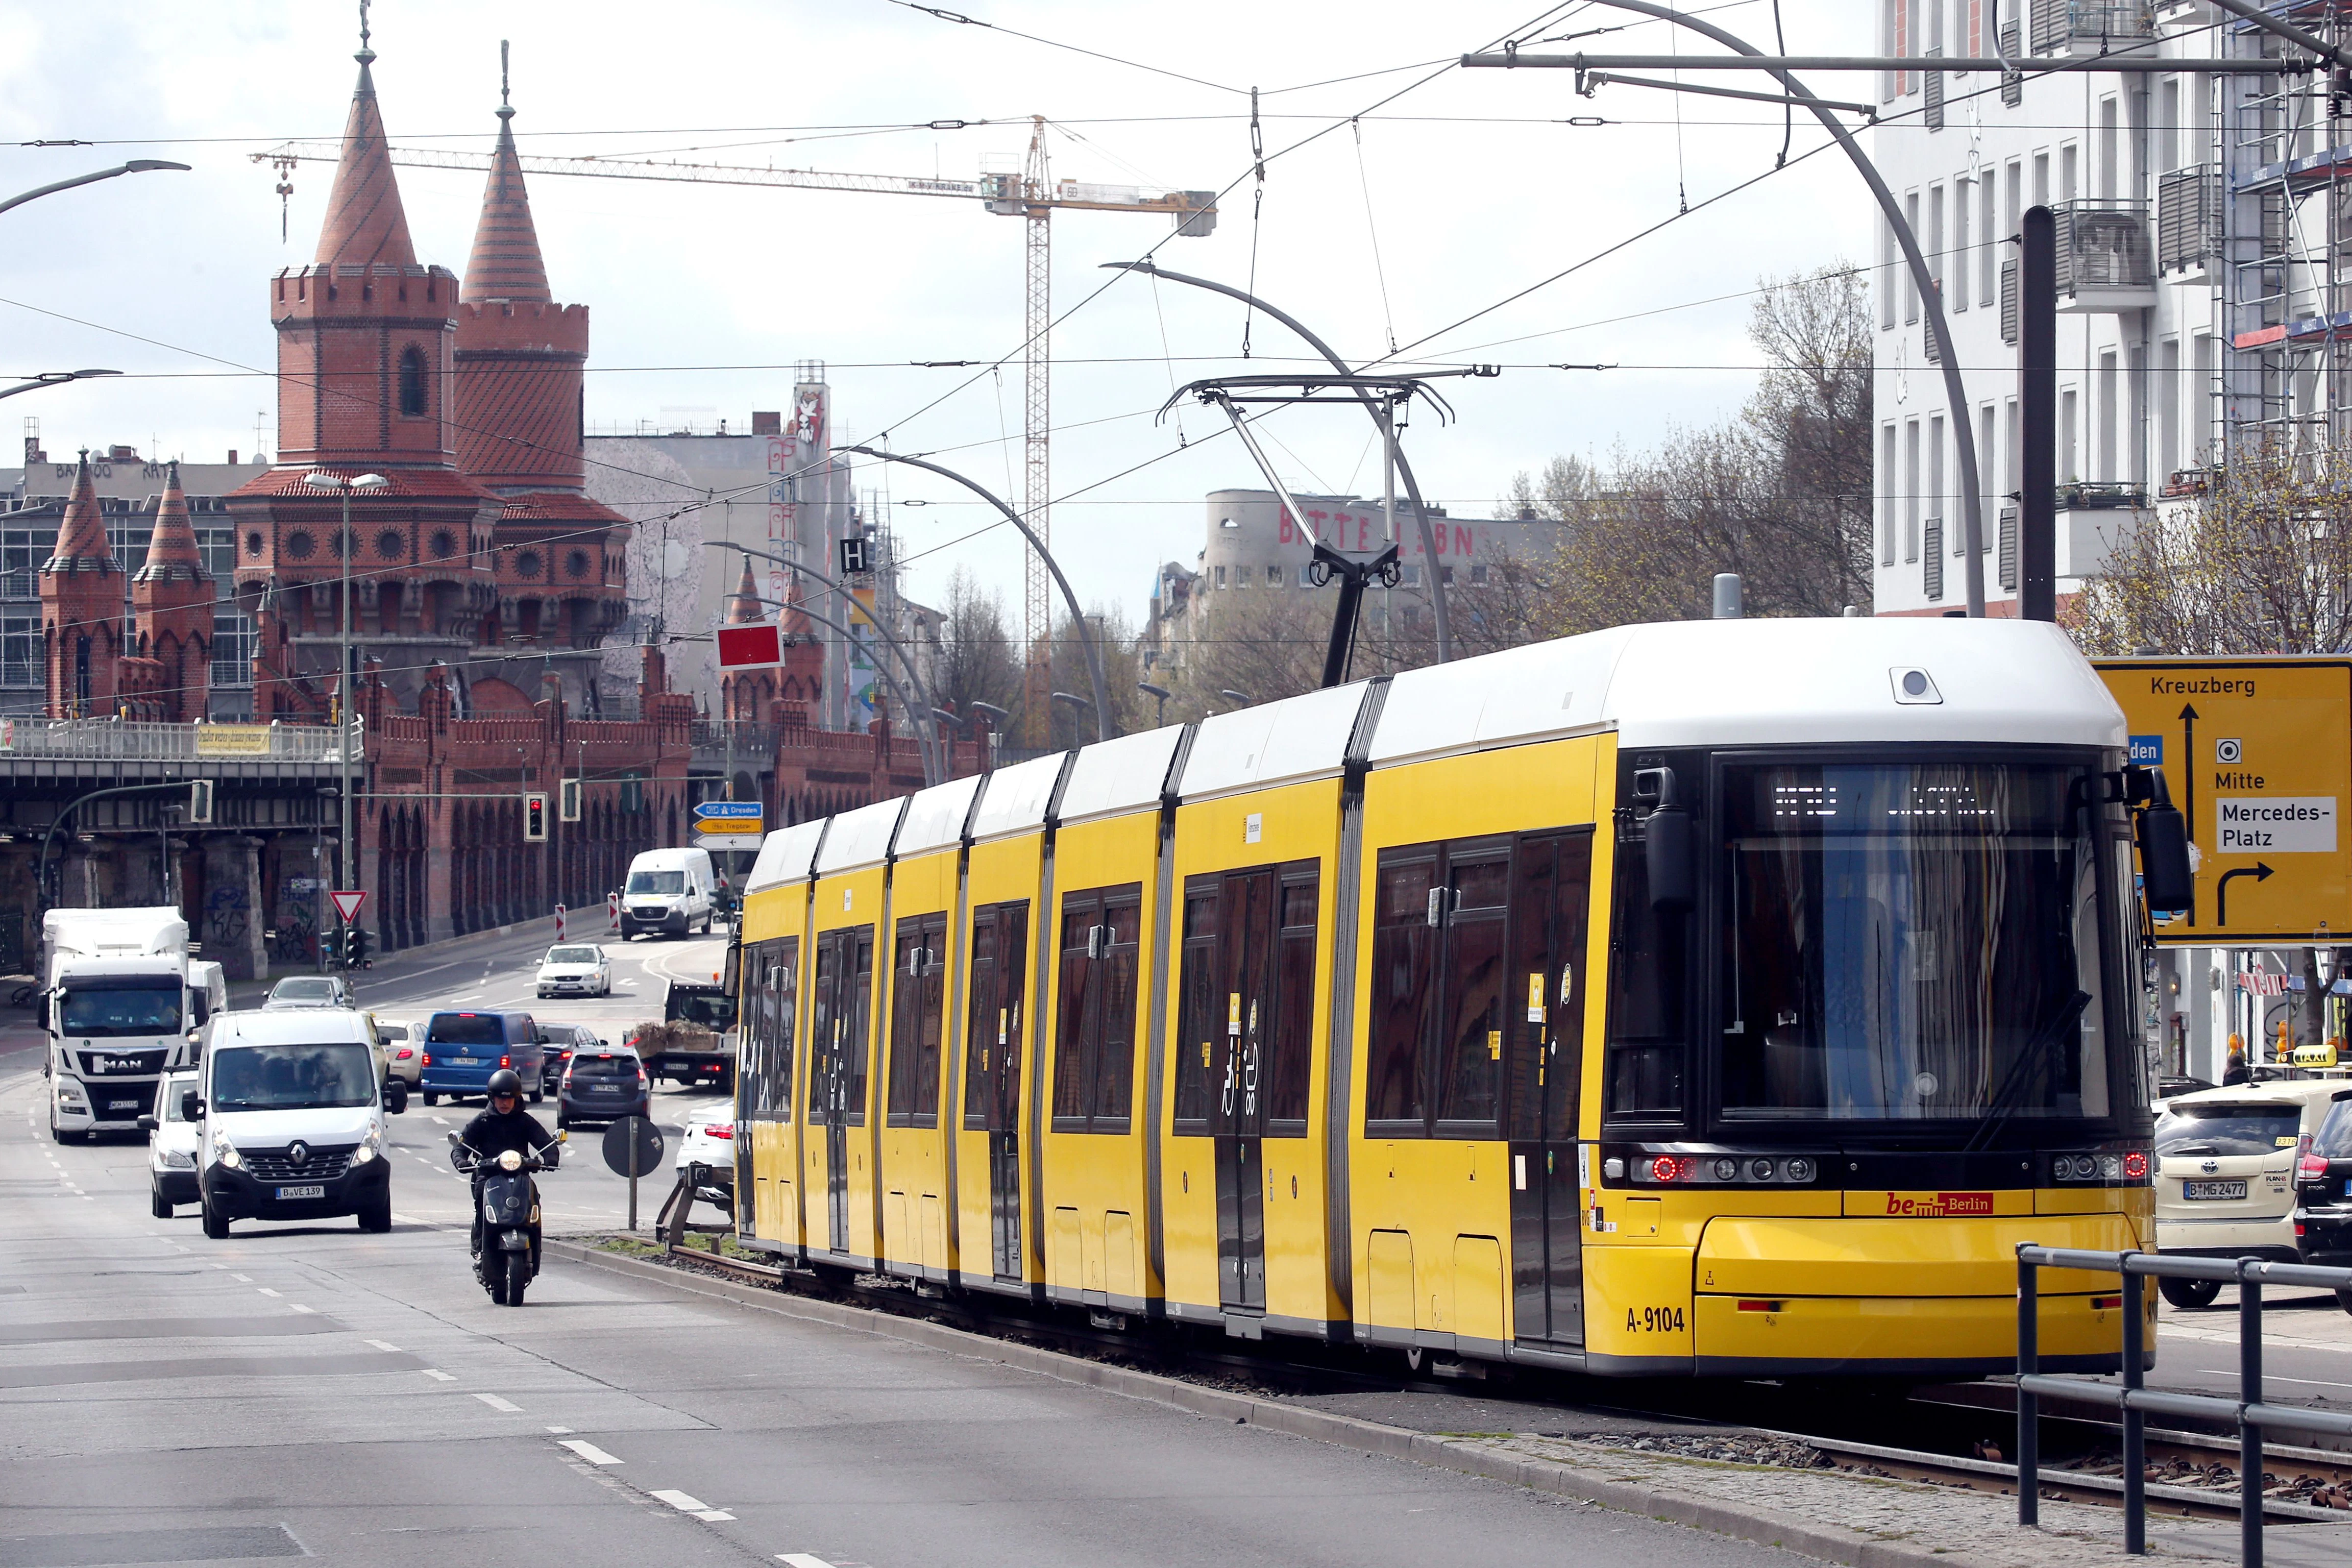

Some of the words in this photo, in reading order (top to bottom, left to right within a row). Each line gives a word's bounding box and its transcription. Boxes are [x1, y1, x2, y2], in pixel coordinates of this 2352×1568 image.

[2302, 154, 2318, 169] HAUBITZ
[57, 464, 111, 479] BAOO
[1279, 504, 1370, 551] BITTE
[844, 542, 863, 569] H
[2151, 677, 2255, 697] Kreuzberg
[2130, 742, 2156, 758] den
[2216, 773, 2265, 789] Mitte
[2223, 804, 2330, 821] Mercedes-
[2223, 829, 2272, 846] Platz
[104, 1060, 141, 1068] MAN
[2296, 1052, 2326, 1062] TAXI
[2190, 1186, 2196, 1195] B
[2204, 1184, 2216, 1195] MG
[2219, 1183, 2244, 1195] 2477
[1886, 1192, 1914, 1214] be
[1948, 1198, 1988, 1210] Berlin
